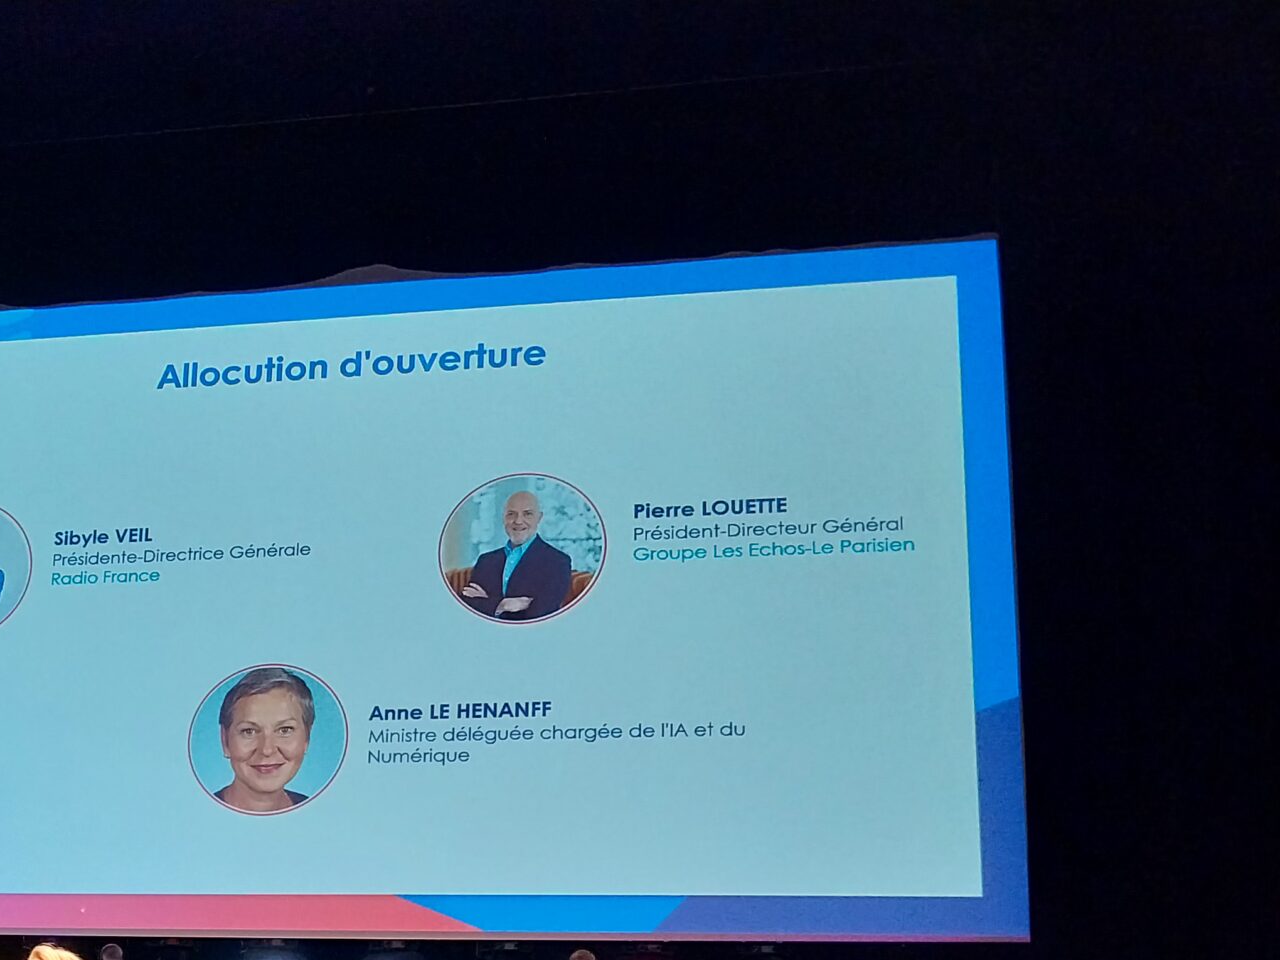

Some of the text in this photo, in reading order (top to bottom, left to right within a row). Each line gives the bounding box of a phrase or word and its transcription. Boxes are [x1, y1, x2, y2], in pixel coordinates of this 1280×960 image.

[156, 343, 547, 390] Allocution d'ouverture
[633, 497, 788, 519] Pierre LOUETTE
[53, 528, 153, 548] Sibyle VEIL
[633, 516, 904, 541] Président-Directeur Général
[52, 542, 312, 567] Présidente-Directrice Générale
[633, 537, 915, 564] Groupe Les Echos-Le Parisien
[51, 569, 161, 586] Radio France
[368, 701, 552, 721] Anne LE HENANFF
[368, 727, 437, 744] Ministre
[442, 725, 535, 745] déléguée
[540, 723, 623, 743] chargée
[628, 722, 656, 739] de
[693, 721, 715, 737] et
[719, 721, 747, 737] du
[367, 747, 471, 766] Numérique
